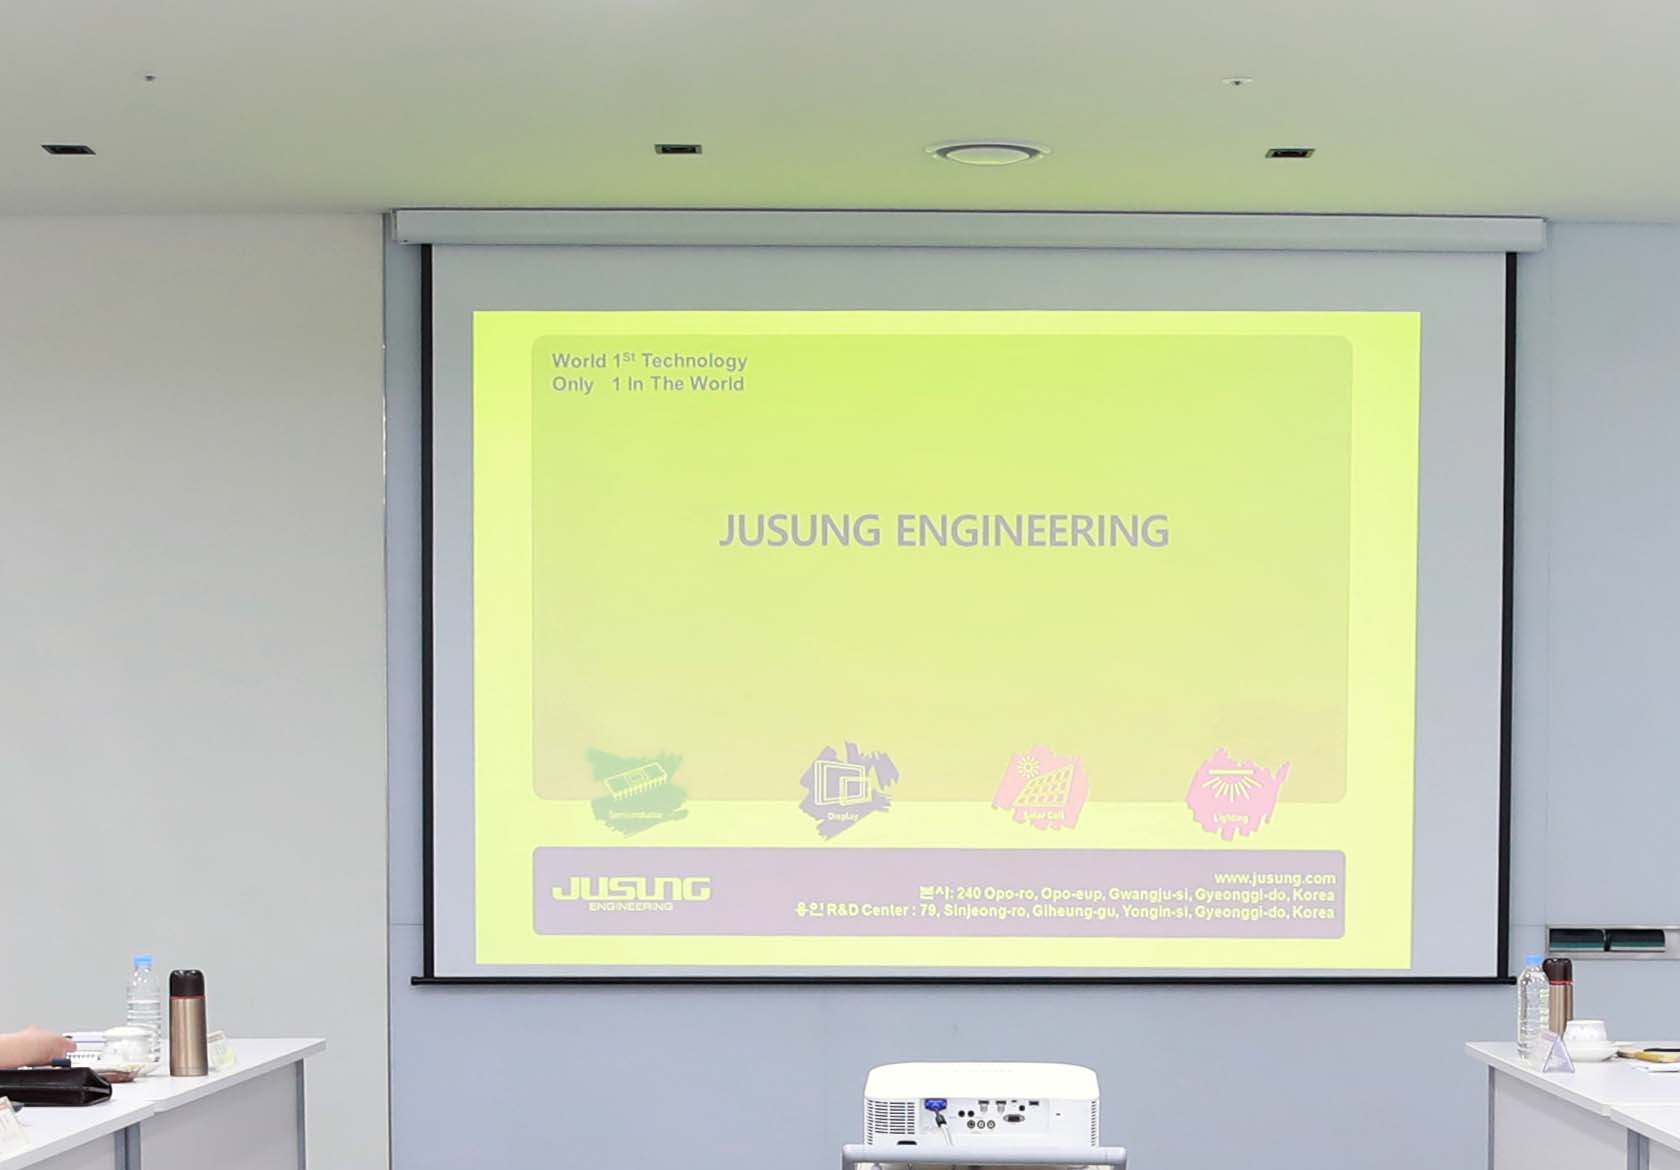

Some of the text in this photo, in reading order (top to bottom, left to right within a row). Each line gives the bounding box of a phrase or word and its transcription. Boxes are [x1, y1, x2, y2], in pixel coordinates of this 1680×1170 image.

[552, 353, 607, 369] World
[641, 352, 748, 373] Technology
[552, 375, 745, 396] Only 1 In The World
[719, 513, 1170, 548] JUSUNG ENGINEERING
[1214, 872, 1337, 887] www.jusung.com
[984, 886, 1038, 902] Opo-ro,
[1195, 888, 1290, 903] Gyeonggi-do,
[1293, 889, 1335, 901] Korea
[827, 903, 859, 917] R&D
[862, 903, 909, 917] Center
[1195, 905, 1290, 920] Gyeonggi-do,
[1292, 905, 1335, 919] Korea
